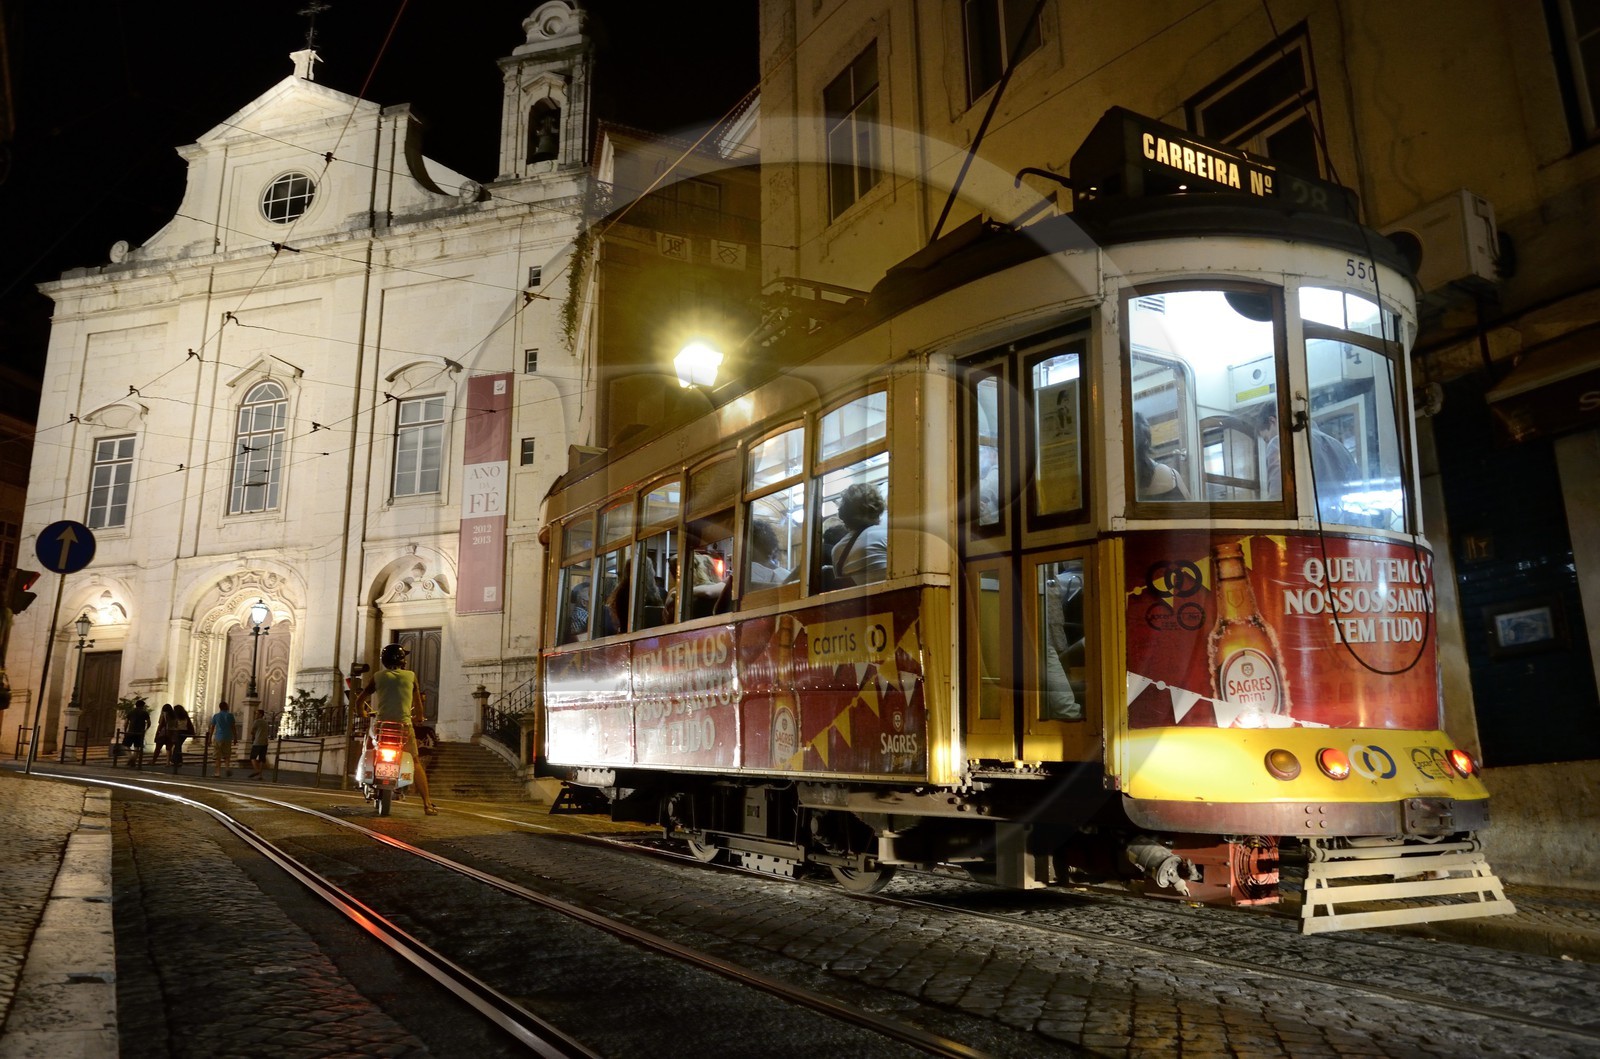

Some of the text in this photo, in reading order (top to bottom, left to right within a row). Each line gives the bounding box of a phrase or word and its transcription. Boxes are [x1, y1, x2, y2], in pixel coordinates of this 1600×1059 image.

[1142, 132, 1273, 197] CARREIRA Nº
[1346, 258, 1377, 283] 550
[469, 465, 500, 480] ANO
[479, 482, 490, 490] DA
[469, 488, 500, 514] FÉ
[472, 535, 492, 545] 2013
[473, 524, 492, 534] 2012
[1303, 557, 1427, 588] QUEM TEM OS
[1283, 585, 1434, 615] NOSSOS SANTOS
[813, 627, 857, 656] carris
[1329, 617, 1423, 644] TEM TUDO
[666, 639, 699, 673] TEM
[702, 632, 727, 667] OS
[1228, 675, 1272, 696] SAGRES
[1239, 690, 1266, 704] mini
[670, 715, 716, 754] TUDO
[774, 730, 794, 746] SAGRES
[880, 732, 918, 755] SAGRES
